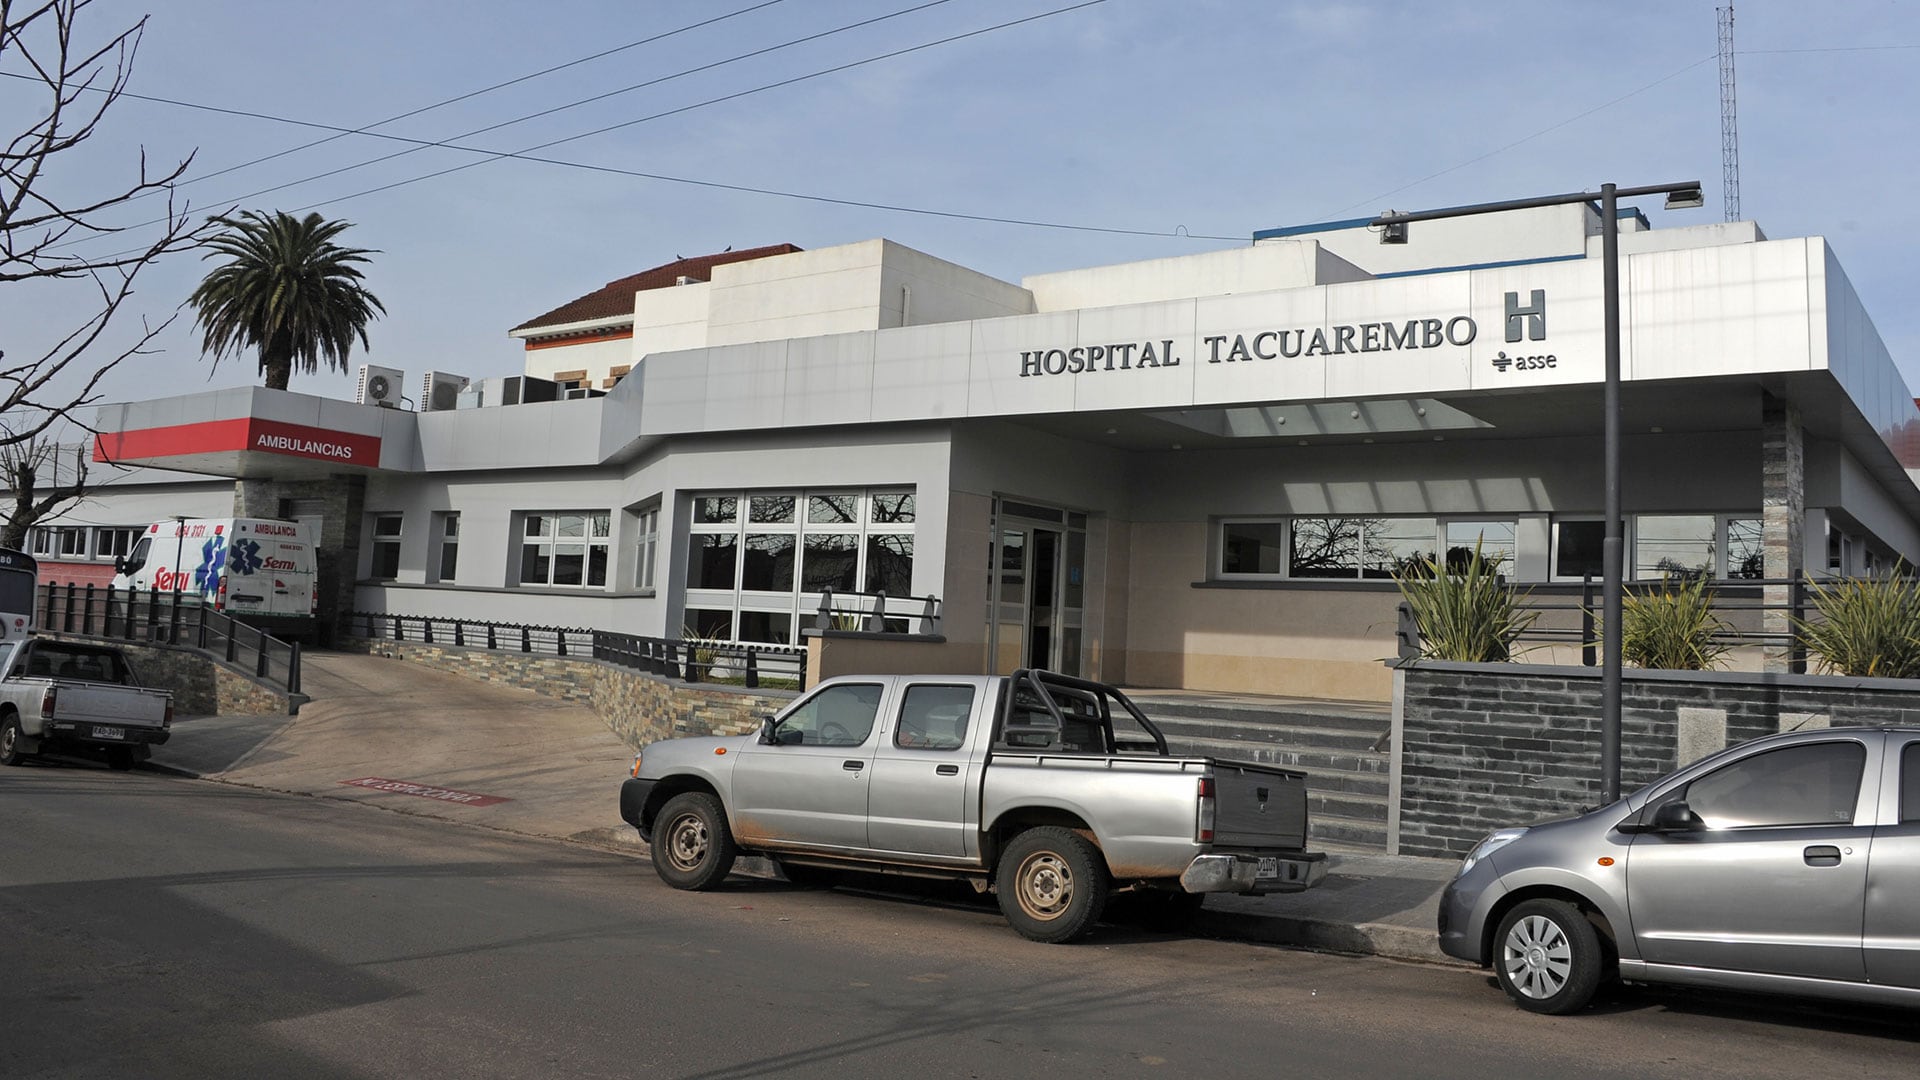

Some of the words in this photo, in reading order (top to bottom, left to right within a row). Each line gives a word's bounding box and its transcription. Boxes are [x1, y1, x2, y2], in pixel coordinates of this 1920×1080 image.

[1019, 339, 1180, 377] HOSPITAL
[1204, 315, 1478, 364] TACUAREMBO
[1515, 354, 1557, 370] asse
[257, 434, 352, 458] AMBULANCIAS
[254, 523, 297, 537] AMBULANCIA
[263, 556, 295, 570] Semi
[152, 566, 190, 591] Semi
